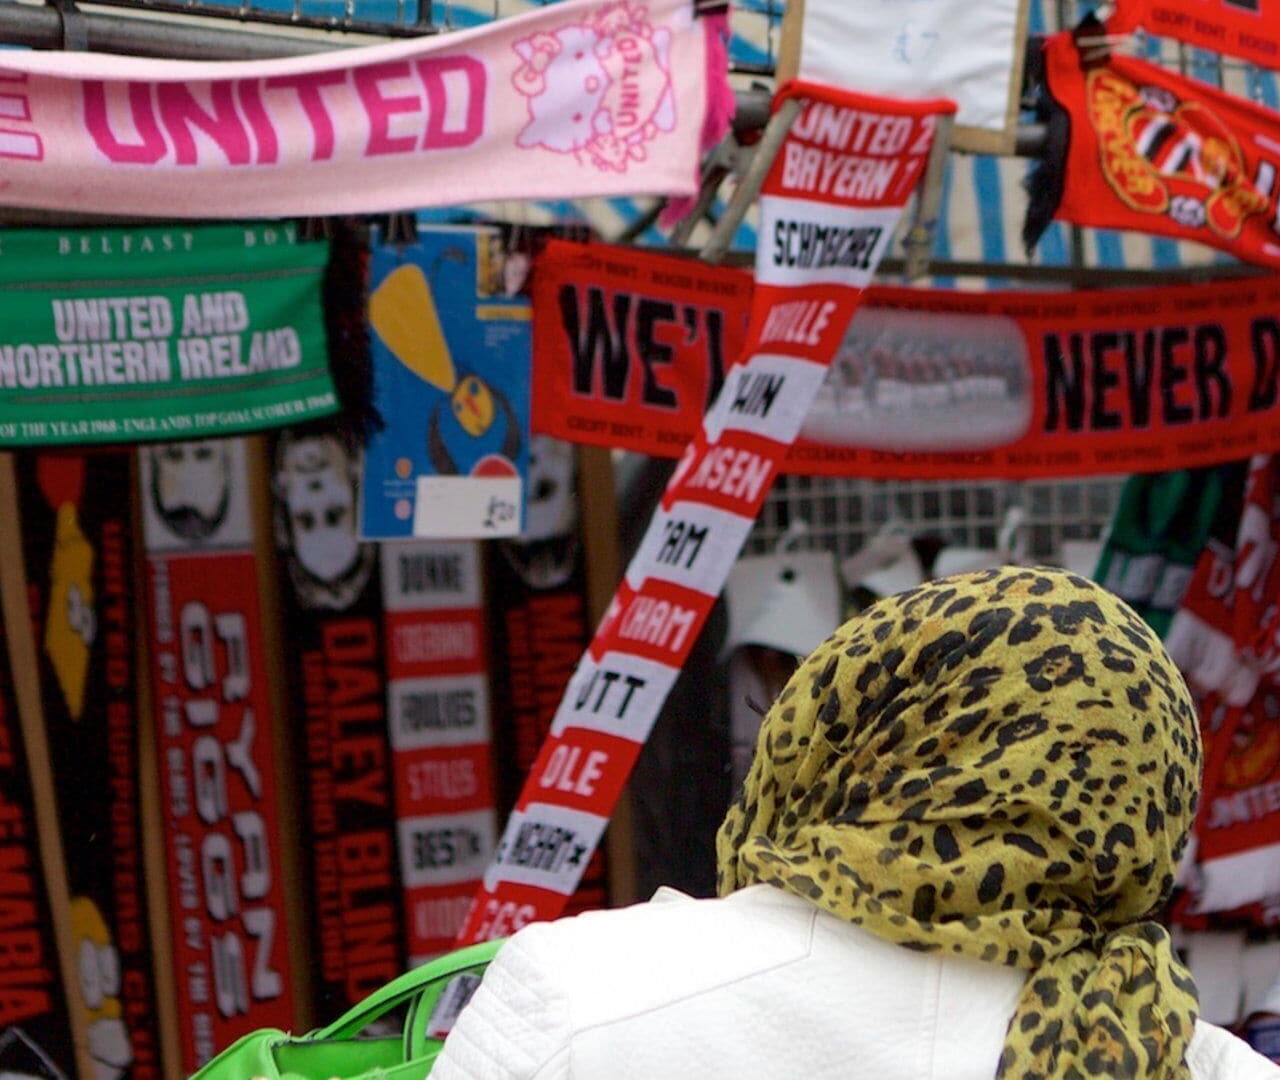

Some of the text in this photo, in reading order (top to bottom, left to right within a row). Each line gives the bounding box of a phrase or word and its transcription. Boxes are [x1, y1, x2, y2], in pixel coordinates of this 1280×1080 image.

[82, 53, 487, 166] UNITED
[612, 32, 645, 131] UNITED
[790, 104, 934, 155] UNITED 2
[781, 141, 893, 201] BAYERN
[51, 291, 249, 344] UNITED AND
[177, 326, 302, 381] IRELAND
[1042, 322, 1233, 433] NEVER
[21, 421, 48, 439] THE
[50, 418, 91, 438] YEAR
[322, 619, 387, 808] DALEY
[574, 671, 648, 720] UTT
[539, 744, 609, 797] OLE
[179, 600, 249, 1020] GIGGS
[214, 611, 282, 1000] RYAN
